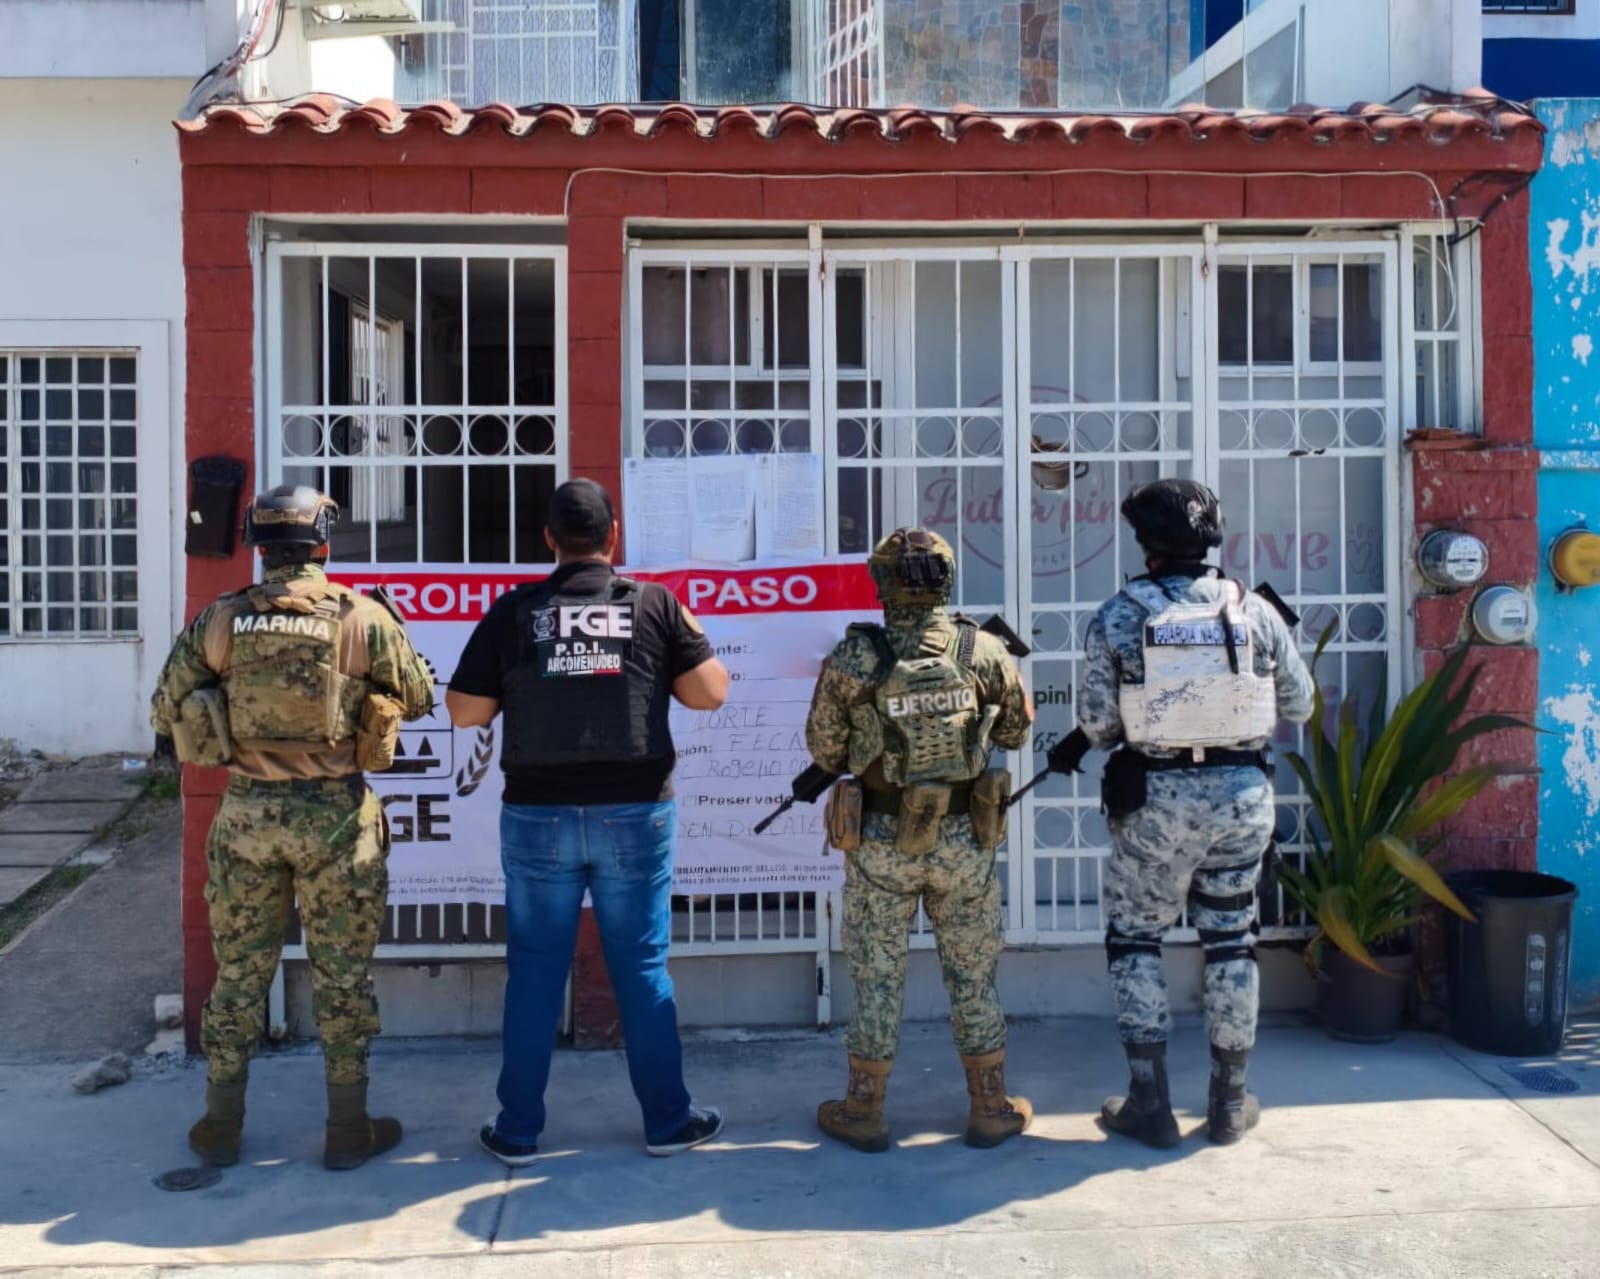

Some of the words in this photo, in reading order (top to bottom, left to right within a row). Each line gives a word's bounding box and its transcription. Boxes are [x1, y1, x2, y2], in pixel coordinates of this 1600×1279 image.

[1225, 531, 1330, 572] ove
[687, 574, 817, 609] PASO
[233, 614, 331, 641] MARINA
[560, 604, 633, 638] FGE
[555, 640, 605, 657] P.D.I.
[887, 688, 973, 717] EJERCITO
